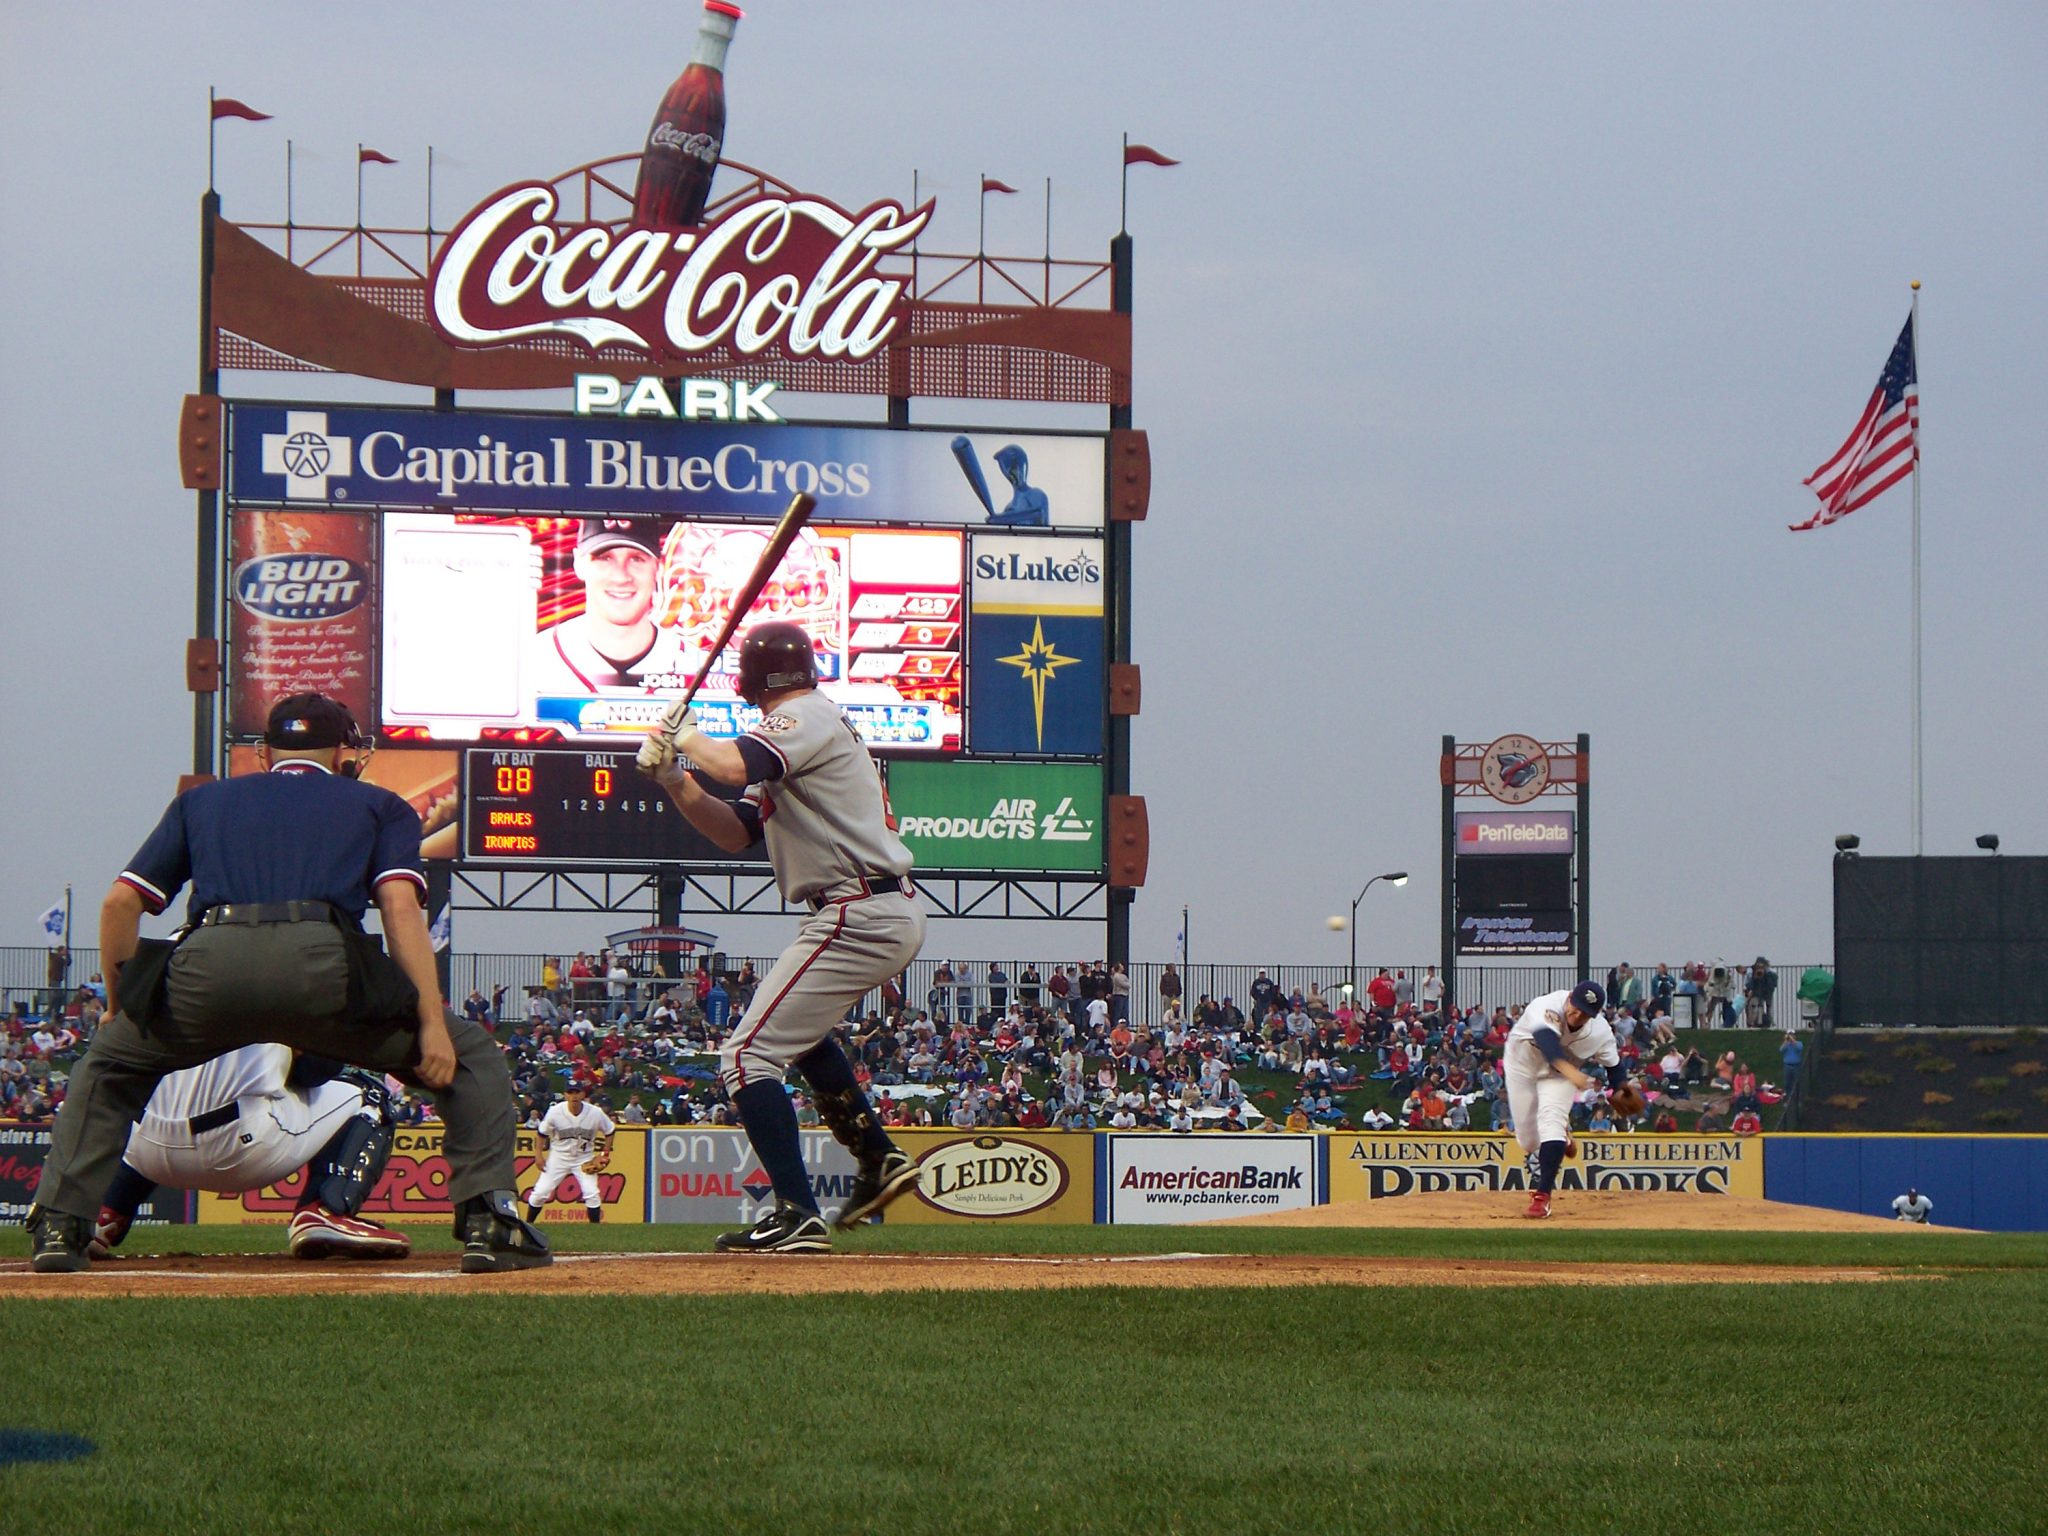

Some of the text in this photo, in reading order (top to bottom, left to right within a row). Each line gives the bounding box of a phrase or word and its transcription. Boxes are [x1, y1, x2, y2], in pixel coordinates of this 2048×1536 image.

[432, 185, 929, 358] Coca-Cola
[574, 374, 787, 423] PARK
[359, 430, 871, 498] Capital BlueCross
[258, 559, 350, 582] BUD
[243, 579, 361, 604] LIGHT
[639, 673, 686, 689] JOSH
[492, 752, 535, 767] AT BAT
[585, 754, 618, 768] BALL
[497, 767, 531, 792] 08
[594, 769, 610, 794] 0
[562, 800, 664, 812] 1 2 3 4 5 6
[990, 798, 1037, 820] AIR
[489, 812, 532, 826] BRAVES
[899, 816, 1036, 840] PRODUCTS
[484, 835, 536, 849] IRONPIGS
[1479, 824, 1569, 841] PenTeleData
[1461, 916, 1533, 929] Ironton
[1473, 929, 1570, 945] Telephone
[0, 1129, 34, 1144] efore
[659, 1134, 831, 1173] on yur
[1349, 1140, 1742, 1161] ALLENTOWN BETHLEHEM
[660, 1173, 742, 1197] DUAL
[931, 1153, 1048, 1199] LEIDY'S
[1120, 1165, 1304, 1190] AmericanBank
[1146, 1191, 1280, 1206] www.pcbanker.com
